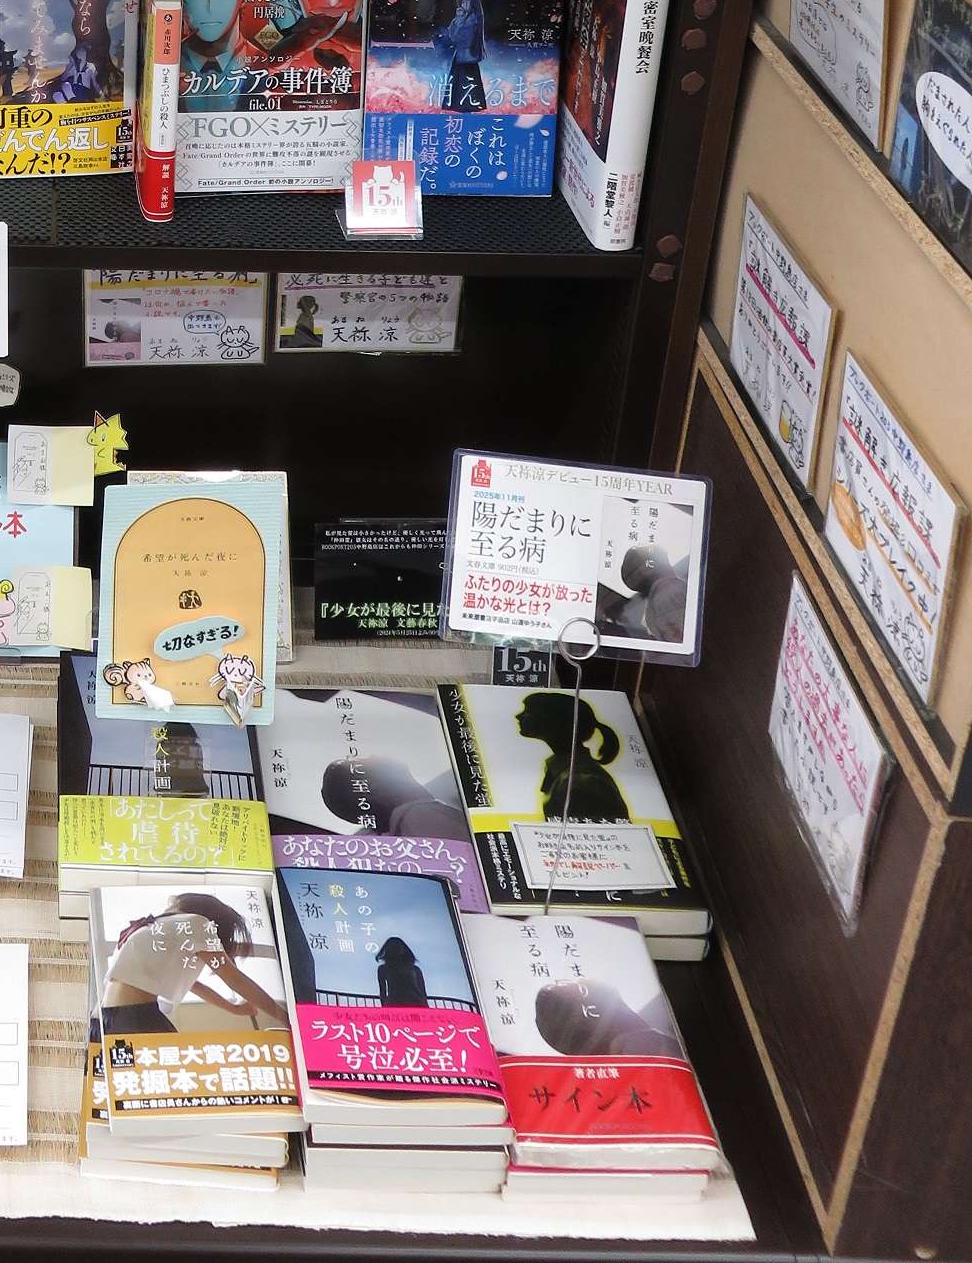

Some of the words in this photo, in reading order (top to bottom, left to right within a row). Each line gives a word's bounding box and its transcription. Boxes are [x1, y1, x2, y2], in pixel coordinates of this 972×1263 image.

[252, 6, 285, 19] 円居挽
[635, 0, 658, 74] 密室晩餐会
[182, 66, 352, 96] カルデアの事件簿
[428, 74, 556, 107] 消えるまで
[159, 67, 171, 131] ひまつぶしの殺人
[191, 116, 348, 138] FGO×ミステリー
[444, 116, 463, 167] 初恋の
[489, 117, 506, 166] これは
[419, 127, 439, 190] 記録だ。
[466, 128, 483, 179] ぼくの
[603, 171, 618, 219] 二階堂黎人
[504, 463, 673, 496] 天祢涼デビュー15周年YEAR
[474, 489, 525, 503] 2025年11月刊
[471, 500, 591, 538] 陽だまりに
[628, 506, 640, 541] 至る病
[143, 553, 237, 563] 希望が死んだ夜に
[467, 536, 546, 564] 至る病
[462, 592, 552, 616] 温かな光とは？
[464, 574, 593, 603] ふたりの少女が放った
[162, 624, 240, 652] 切なすぎる！
[335, 697, 377, 830] 陽だまりに至る病
[282, 835, 468, 865] あなたのお父さん、
[328, 883, 356, 954] 殺人計画
[354, 885, 379, 955] あの子の
[175, 920, 198, 970] 死んだ
[203, 921, 226, 969] 希望が
[311, 1020, 481, 1048] ラスト10ページで
[135, 1043, 291, 1066] 本屋大賞2019
[337, 1044, 468, 1074] 号泣必至！
[111, 1066, 296, 1096] 発掘本で話題!!
[573, 1066, 620, 1080] 著者直筆
[528, 1084, 653, 1115] サイン本
